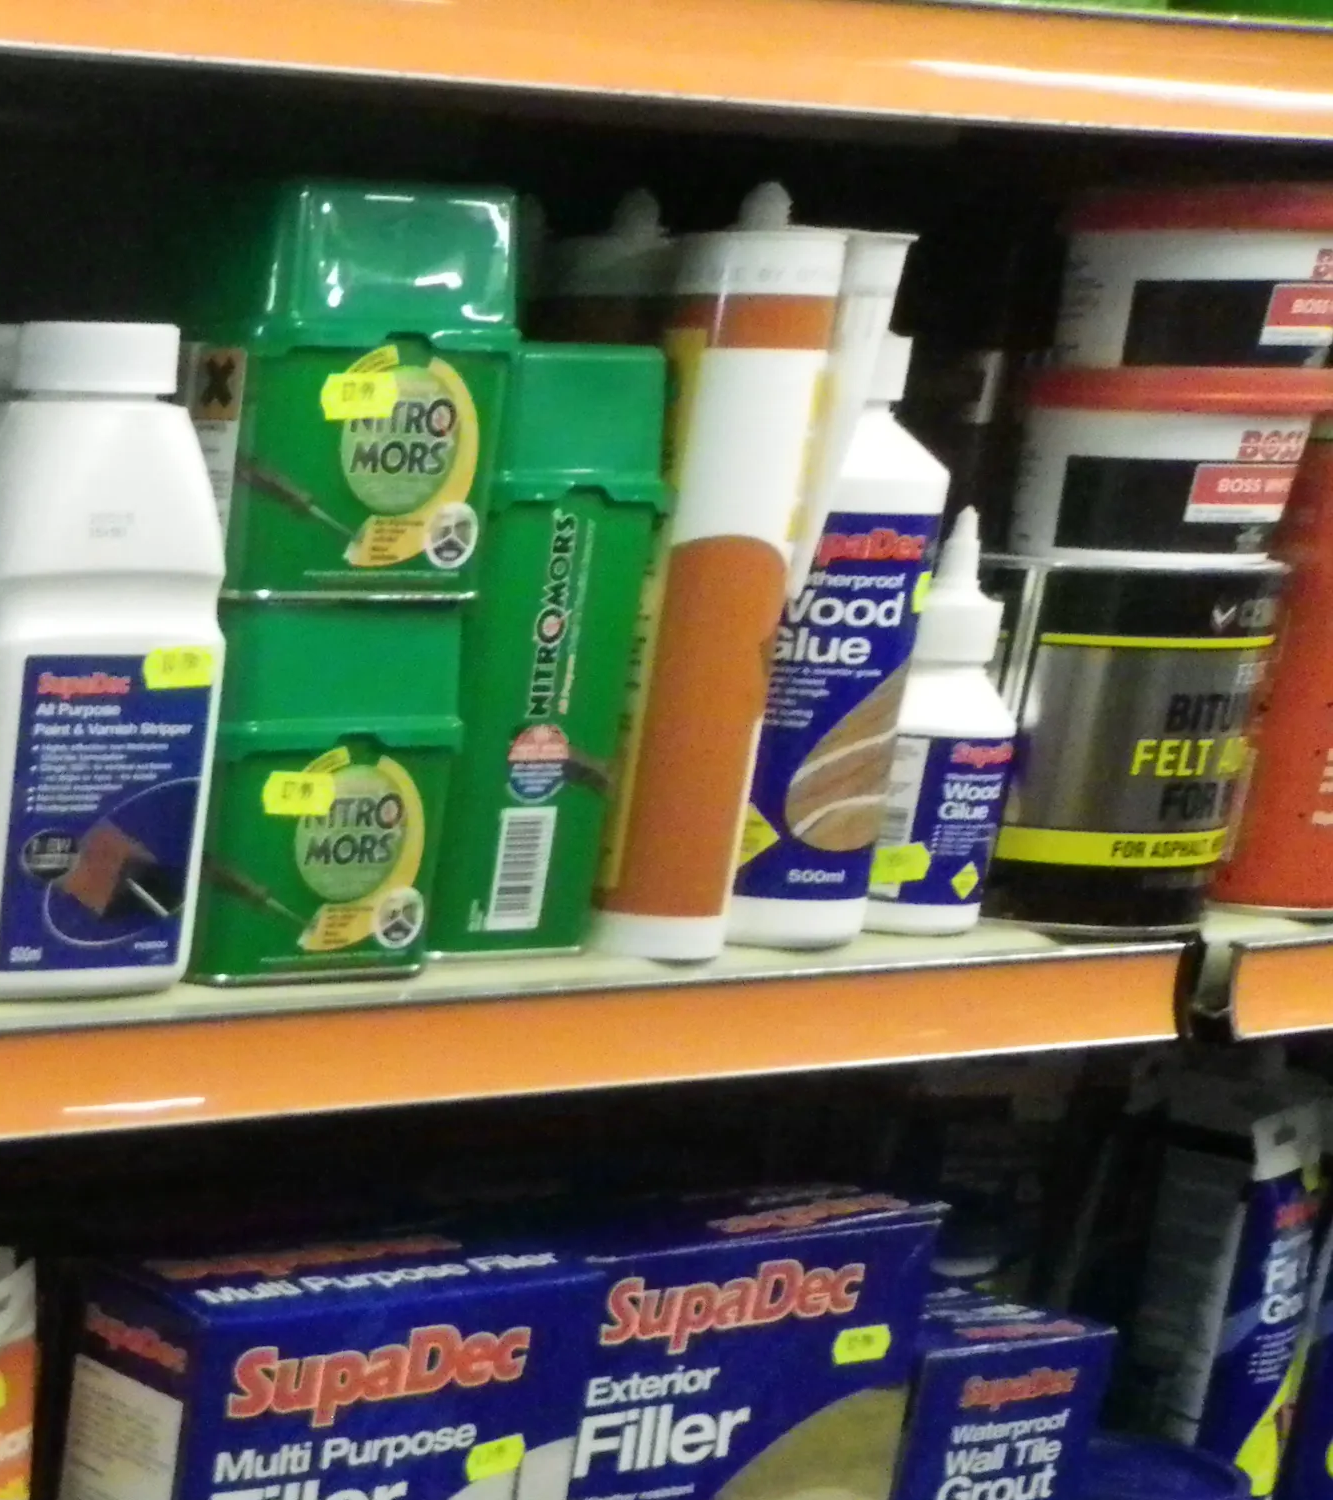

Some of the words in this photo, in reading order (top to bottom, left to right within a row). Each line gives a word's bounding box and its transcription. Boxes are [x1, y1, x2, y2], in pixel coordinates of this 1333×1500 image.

[349, 439, 449, 475] MORS
[58, 703, 122, 719] Purpose
[87, 722, 138, 736] Varnish
[140, 722, 194, 737] Stripper
[1129, 738, 1215, 777] FELT
[943, 783, 1003, 800] Wood
[938, 801, 989, 822] Glue
[303, 831, 395, 867] MORS
[307, 1261, 468, 1296] Purpose
[467, 1248, 561, 1276] Filler
[600, 1258, 867, 1355] SupaDec
[224, 1323, 532, 1429] SupaDec
[584, 1364, 721, 1408] Exterior
[571, 1403, 752, 1479] Filler
[951, 1408, 1072, 1446] Waterproof
[213, 1440, 313, 1484] Multi
[319, 1421, 479, 1473] Purpose
[944, 1445, 1006, 1478] Wall
[1014, 1438, 1063, 1467] Tile
